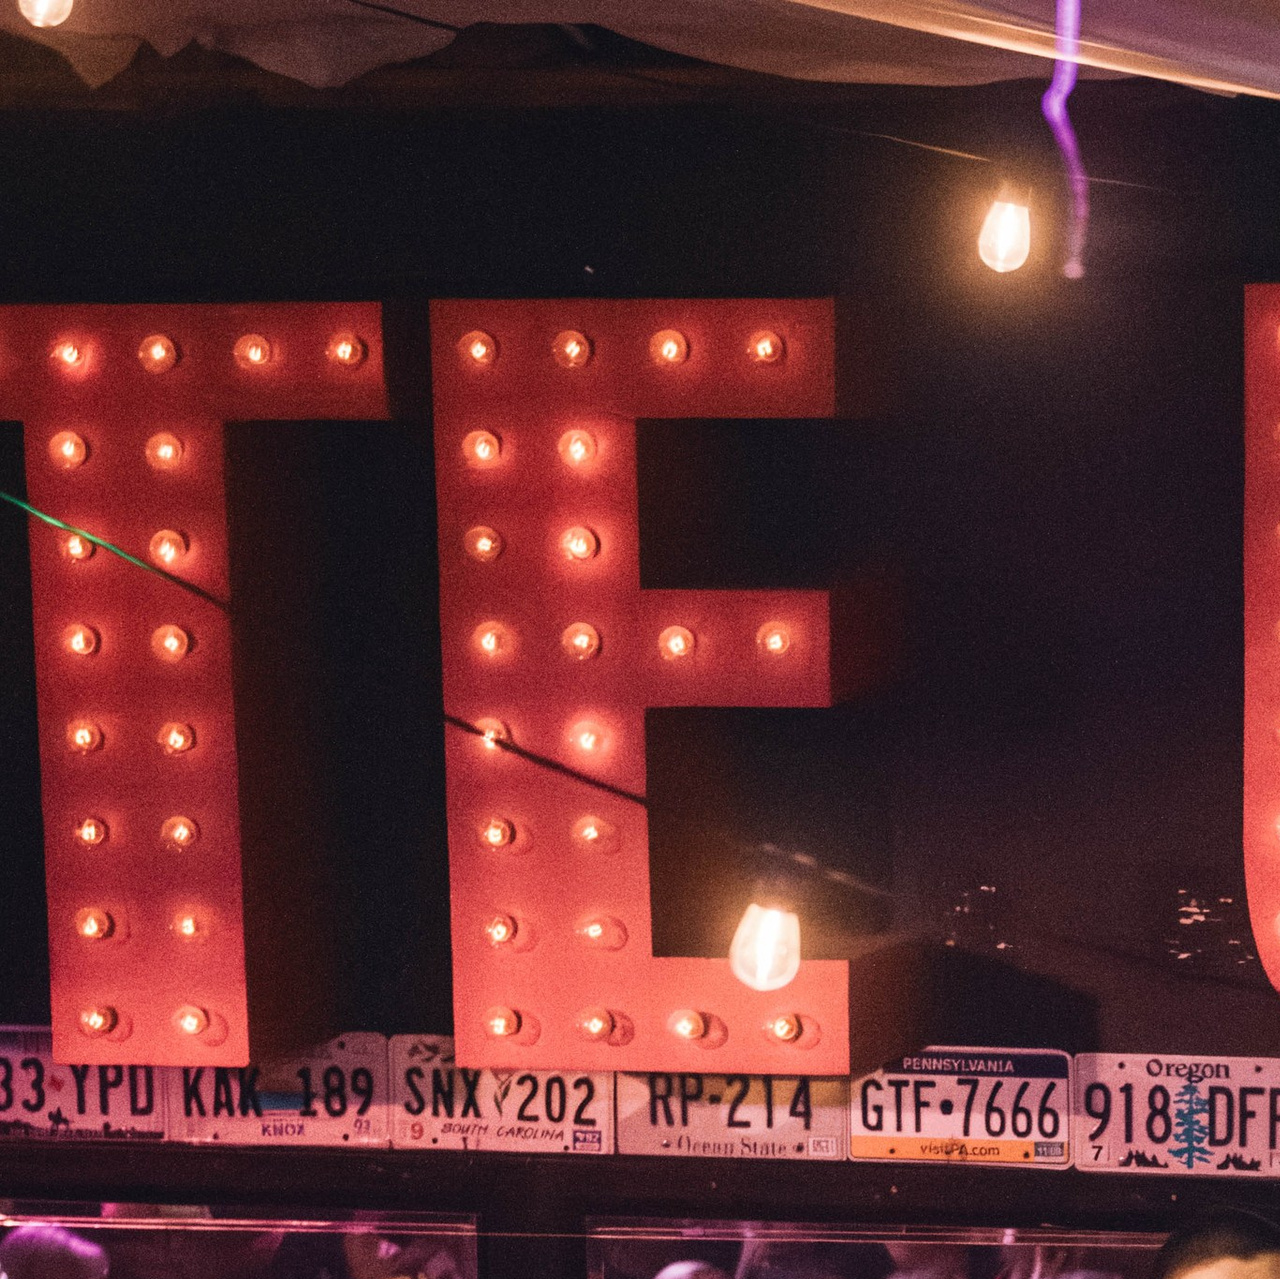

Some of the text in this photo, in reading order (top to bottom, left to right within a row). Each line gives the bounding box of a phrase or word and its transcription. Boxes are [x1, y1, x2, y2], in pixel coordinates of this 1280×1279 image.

[903, 1057, 1014, 1073] PENNSYLVANIA
[1146, 1058, 1230, 1083] Oregon
[70, 1065, 154, 1115] YPD
[183, 1066, 373, 1117] KAK 189
[404, 1067, 596, 1126] SNX 202
[1085, 1082, 1172, 1144] 918
[262, 1122, 305, 1137] KNOX
[441, 1122, 564, 1141] SOUTH CAROLINA
[1092, 1145, 1103, 1161] 7
